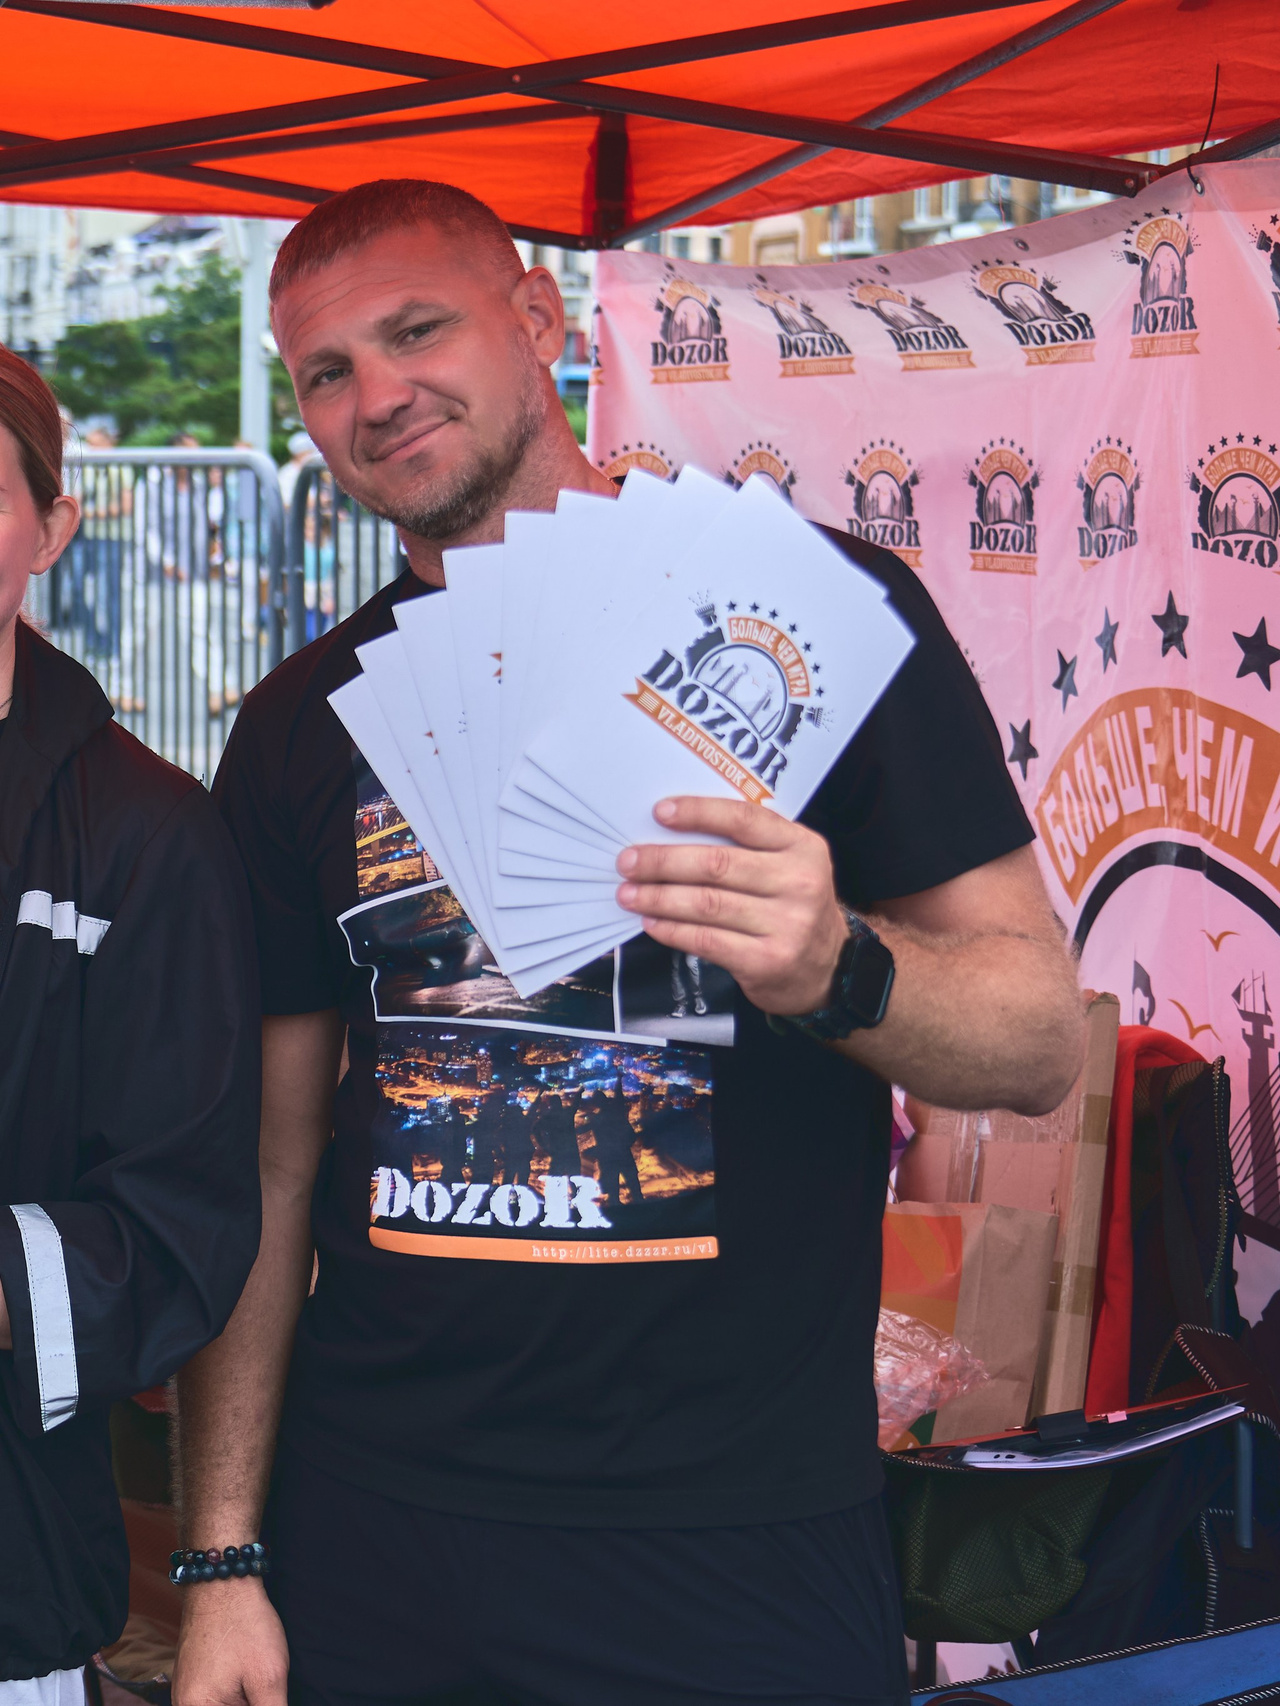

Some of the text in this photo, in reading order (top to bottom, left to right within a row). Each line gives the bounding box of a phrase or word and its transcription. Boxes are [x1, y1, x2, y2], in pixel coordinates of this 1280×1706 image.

[1191, 532, 1280, 568] DOZO
[775, 637, 799, 667] ЧЕМ
[786, 663, 808, 695] ИГРА
[642, 649, 788, 792] DOZOR
[656, 704, 747, 788] VLADIVOSTOK
[1172, 706, 1254, 838] ЧЕМ
